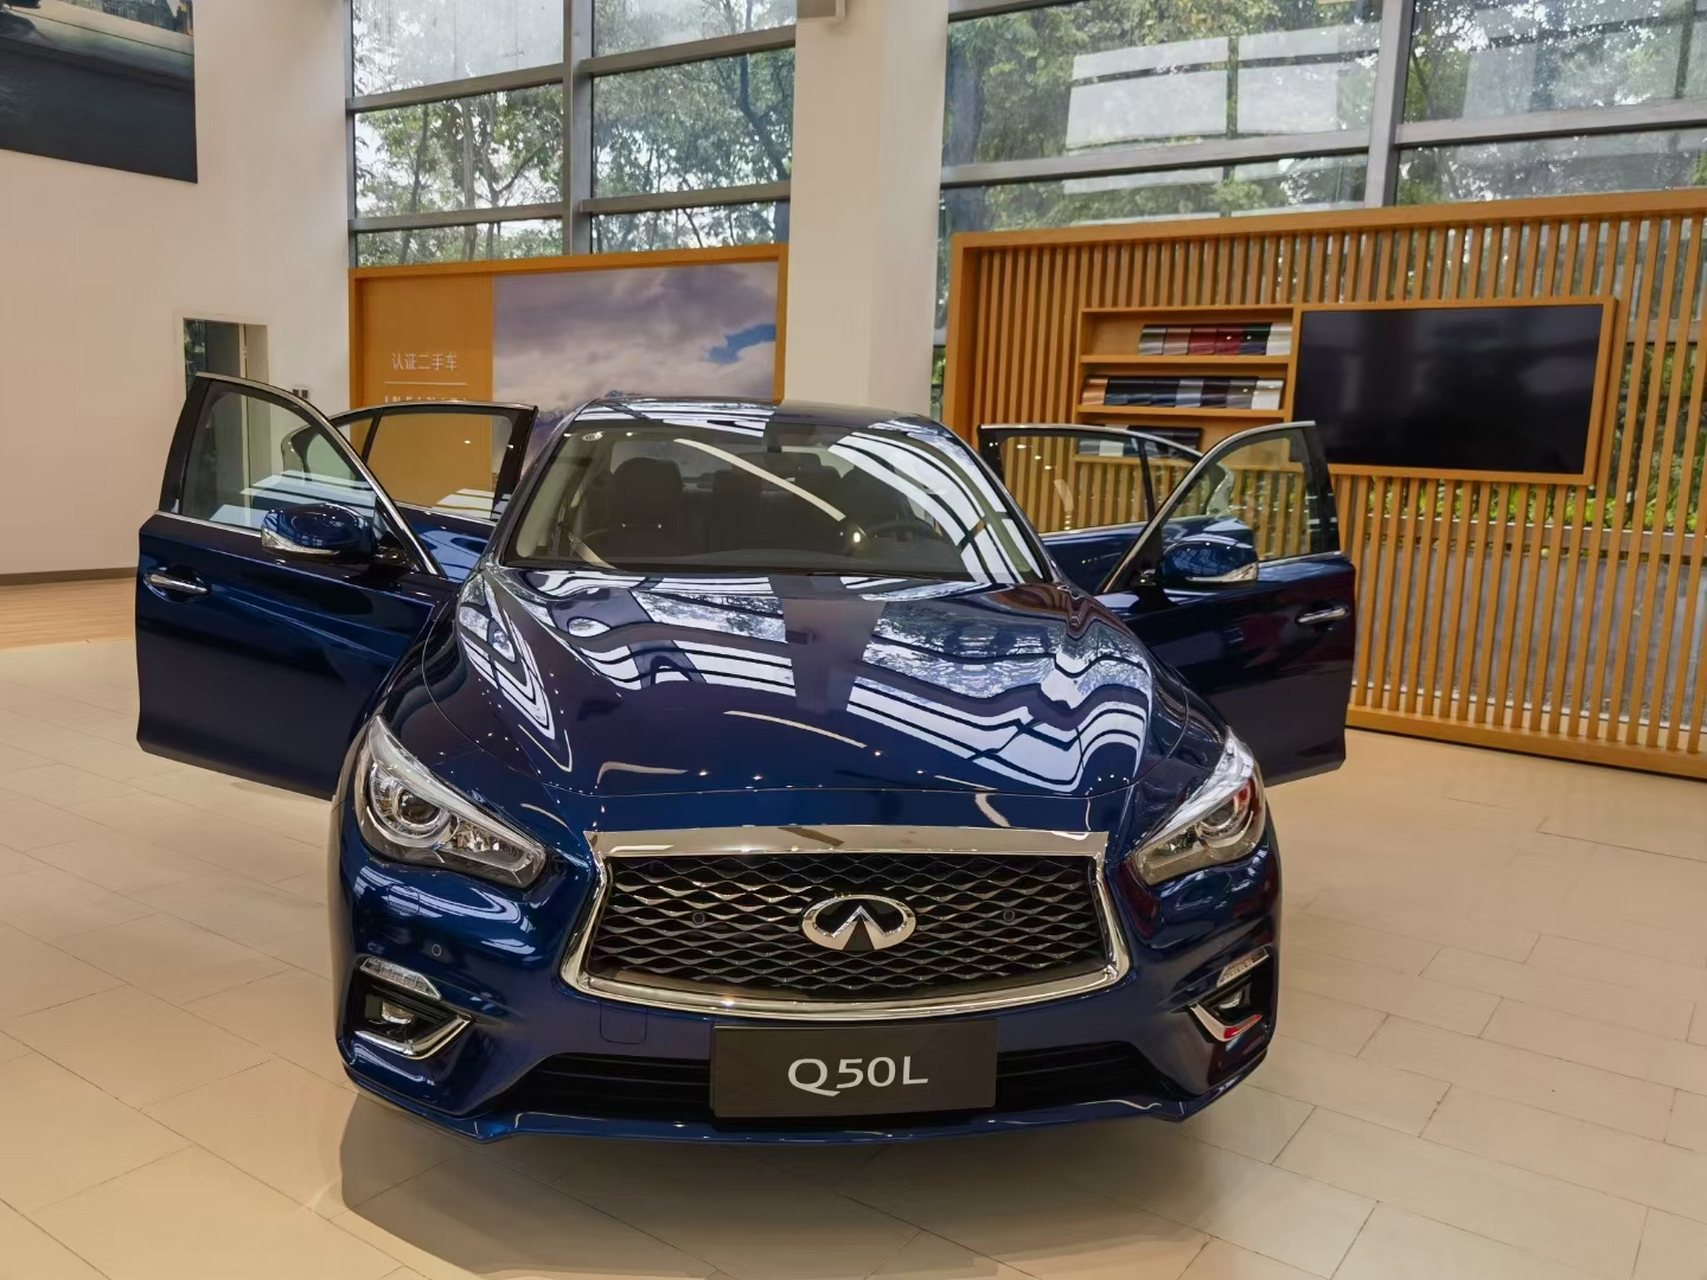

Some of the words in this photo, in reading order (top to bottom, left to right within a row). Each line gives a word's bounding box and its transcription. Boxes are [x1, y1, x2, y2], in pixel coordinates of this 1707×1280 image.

[391, 352, 457, 371] 认证二手车
[787, 1055, 929, 1097] Q50L
